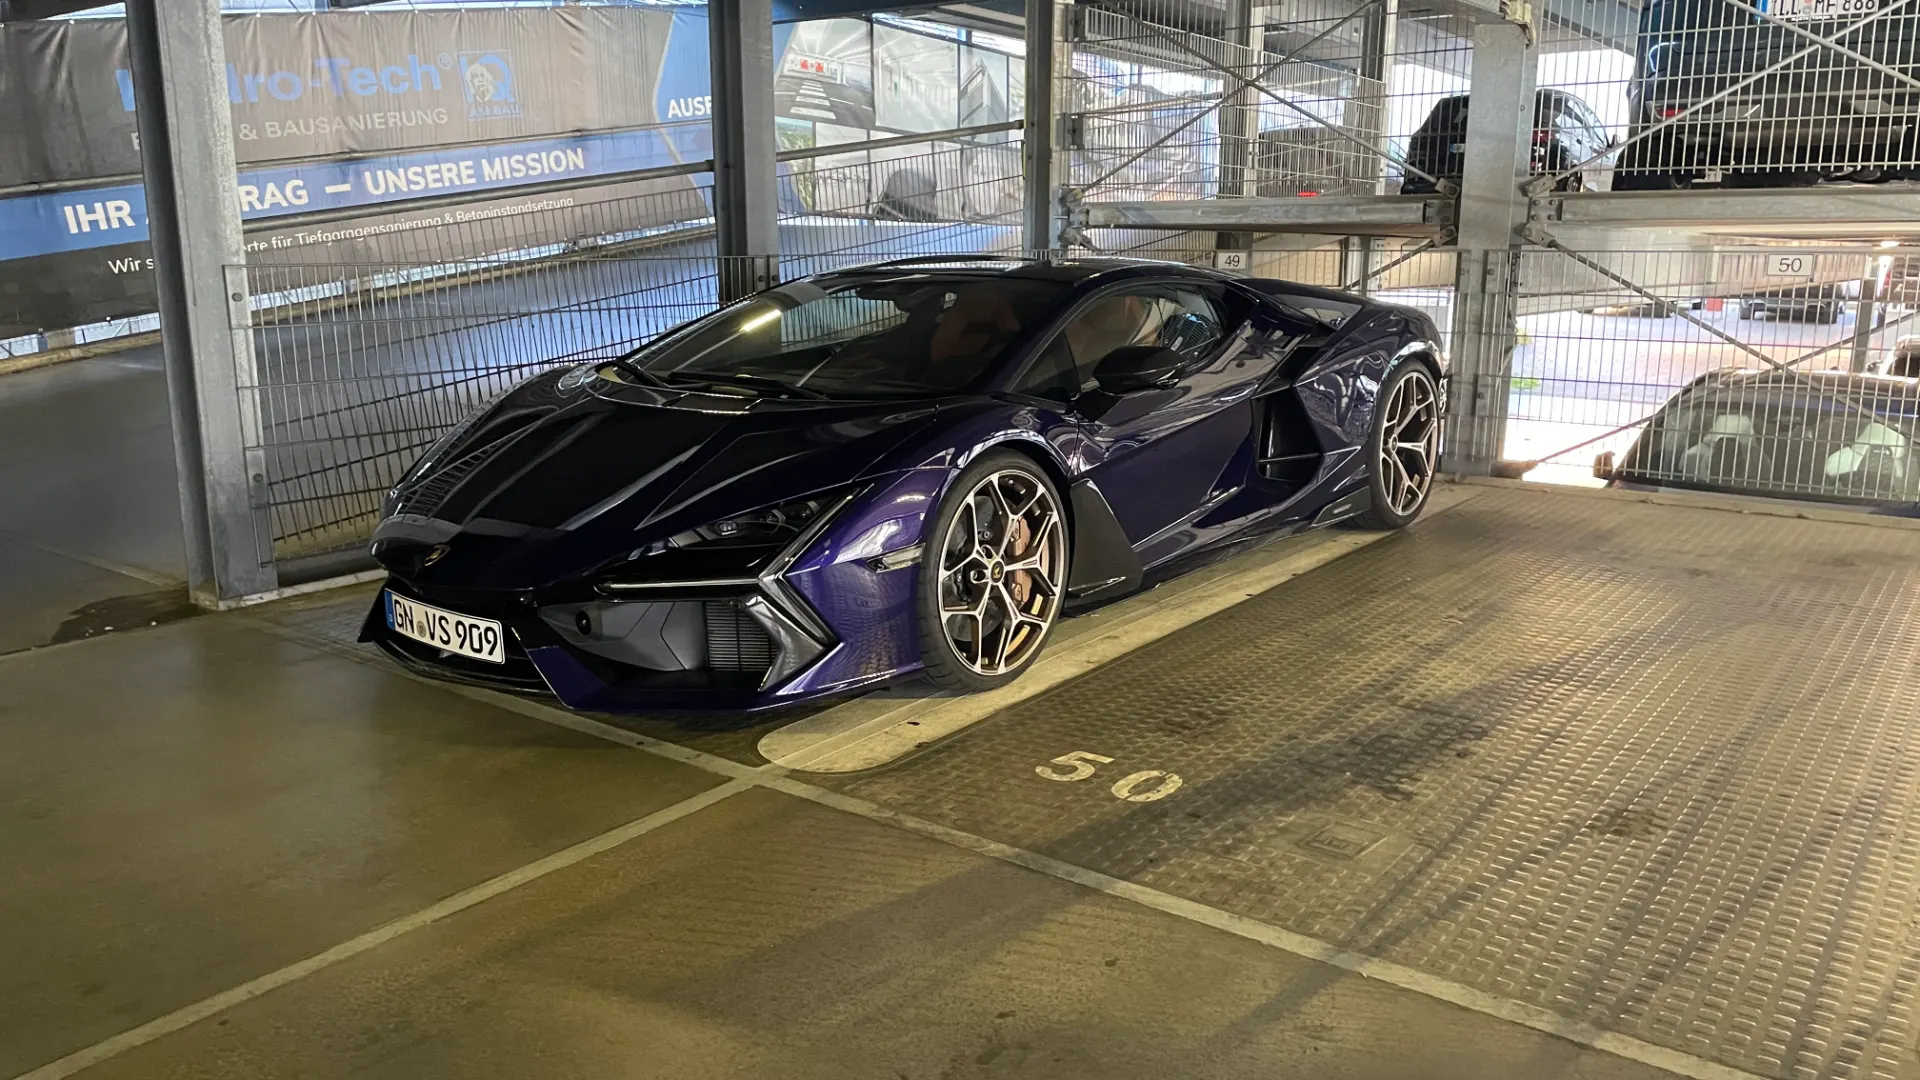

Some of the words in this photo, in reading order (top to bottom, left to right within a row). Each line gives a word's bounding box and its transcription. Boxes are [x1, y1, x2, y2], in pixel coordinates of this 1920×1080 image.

[239, 123, 259, 141] &
[264, 108, 449, 138] BAUSANIERUNG
[668, 95, 712, 119] AUSF
[64, 200, 136, 234] IHR
[365, 161, 477, 195] UNSERE
[481, 148, 585, 182] MISSION
[108, 257, 141, 275] Wir
[271, 236, 293, 250] für
[295, 217, 442, 247] Tiefgaragensanierung
[445, 212, 454, 224] &
[456, 197, 574, 222] Betoninstandsetzung
[1224, 254, 1240, 268] 49
[1778, 257, 1802, 272] 50
[394, 599, 415, 634] GN
[425, 610, 451, 646] VS
[455, 620, 498, 656] 909
[1035, 750, 1184, 802] 50
